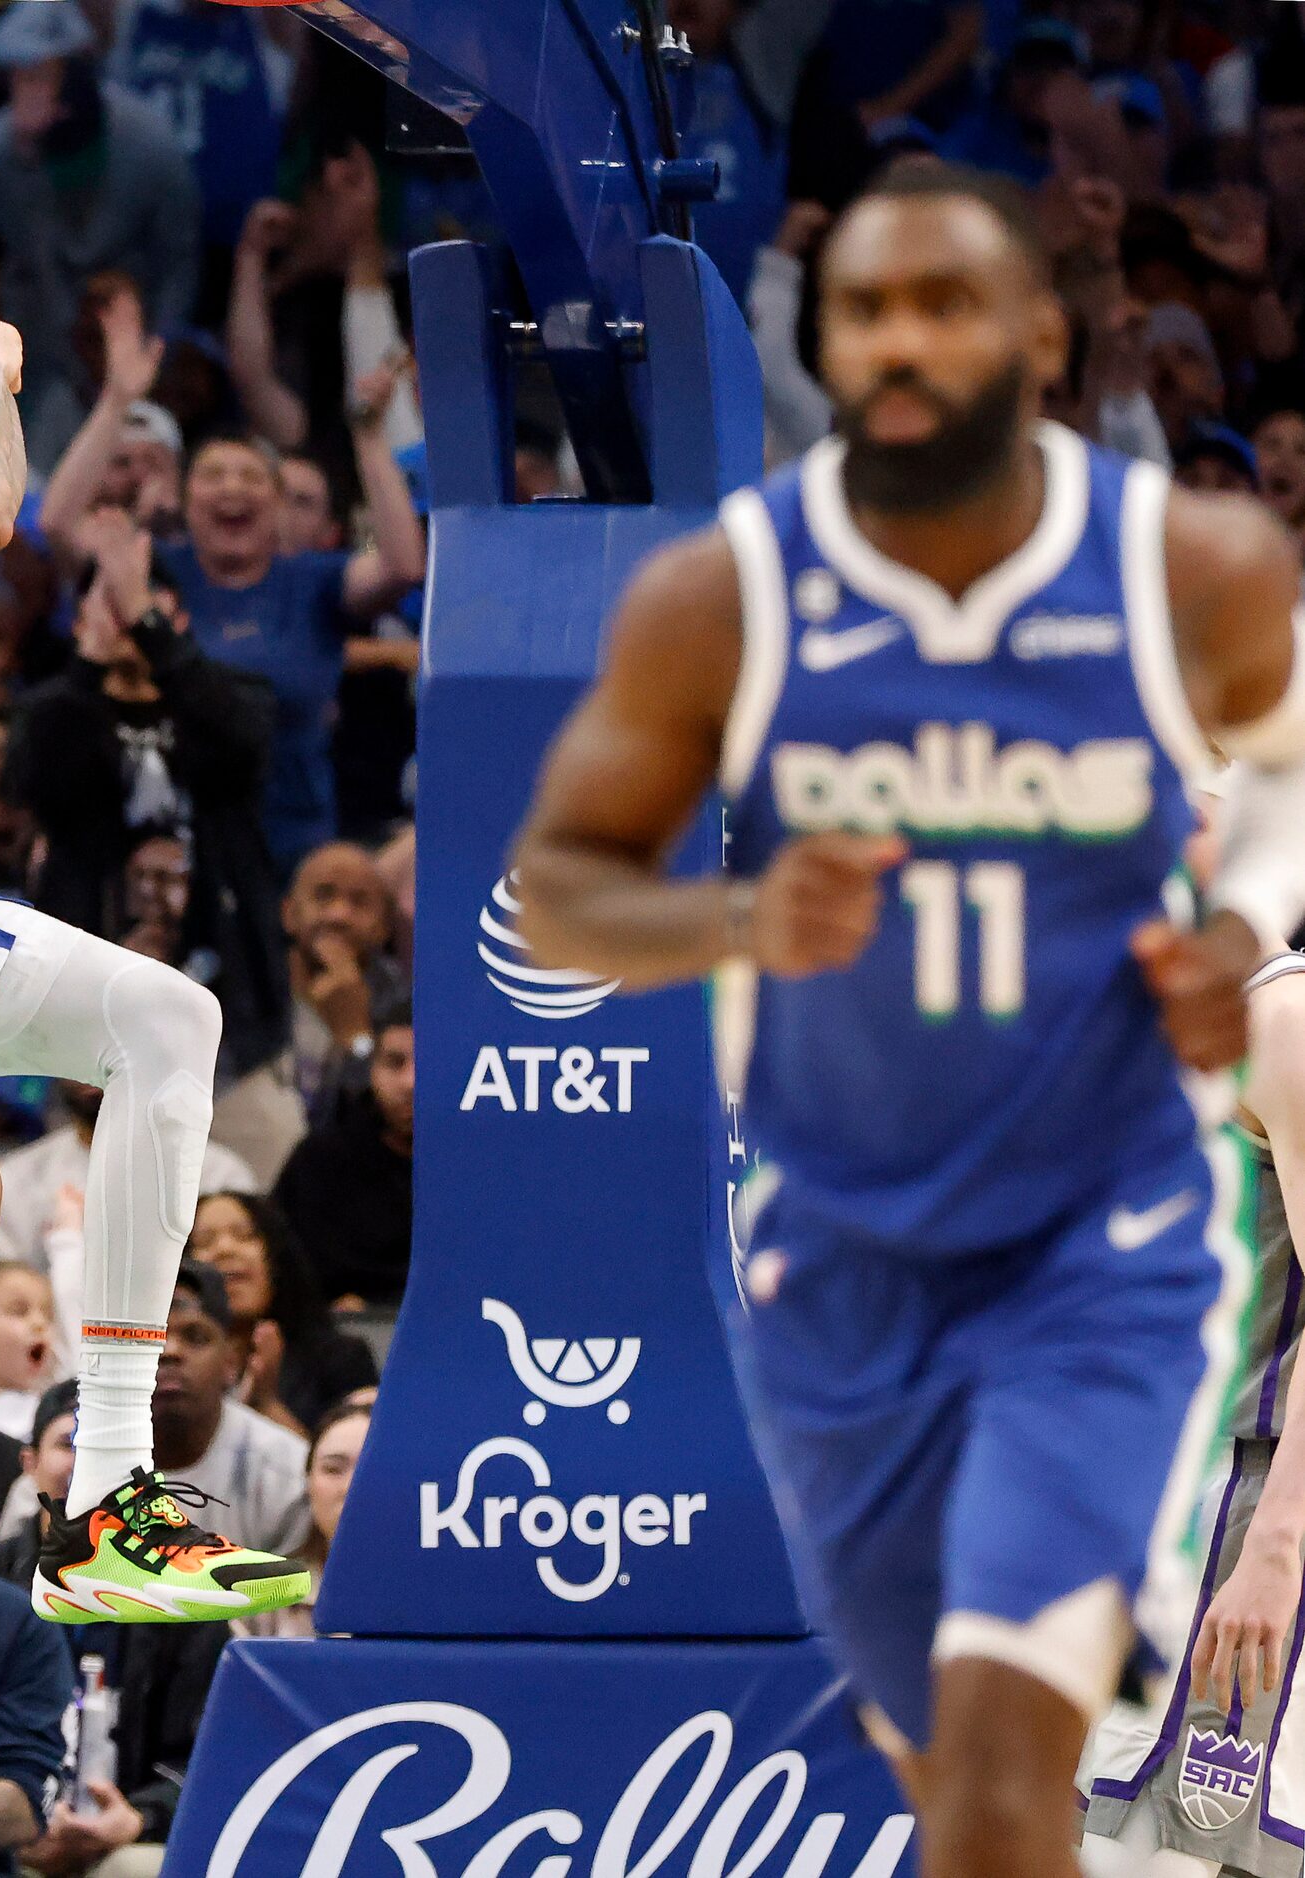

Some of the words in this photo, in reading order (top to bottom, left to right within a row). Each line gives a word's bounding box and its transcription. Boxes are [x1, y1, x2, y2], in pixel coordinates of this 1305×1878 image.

[900, 859, 1026, 1023] 11
[460, 1045, 649, 1113] AT&T
[419, 1436, 707, 1602] Kroger
[1183, 1760, 1255, 1799] SAC
